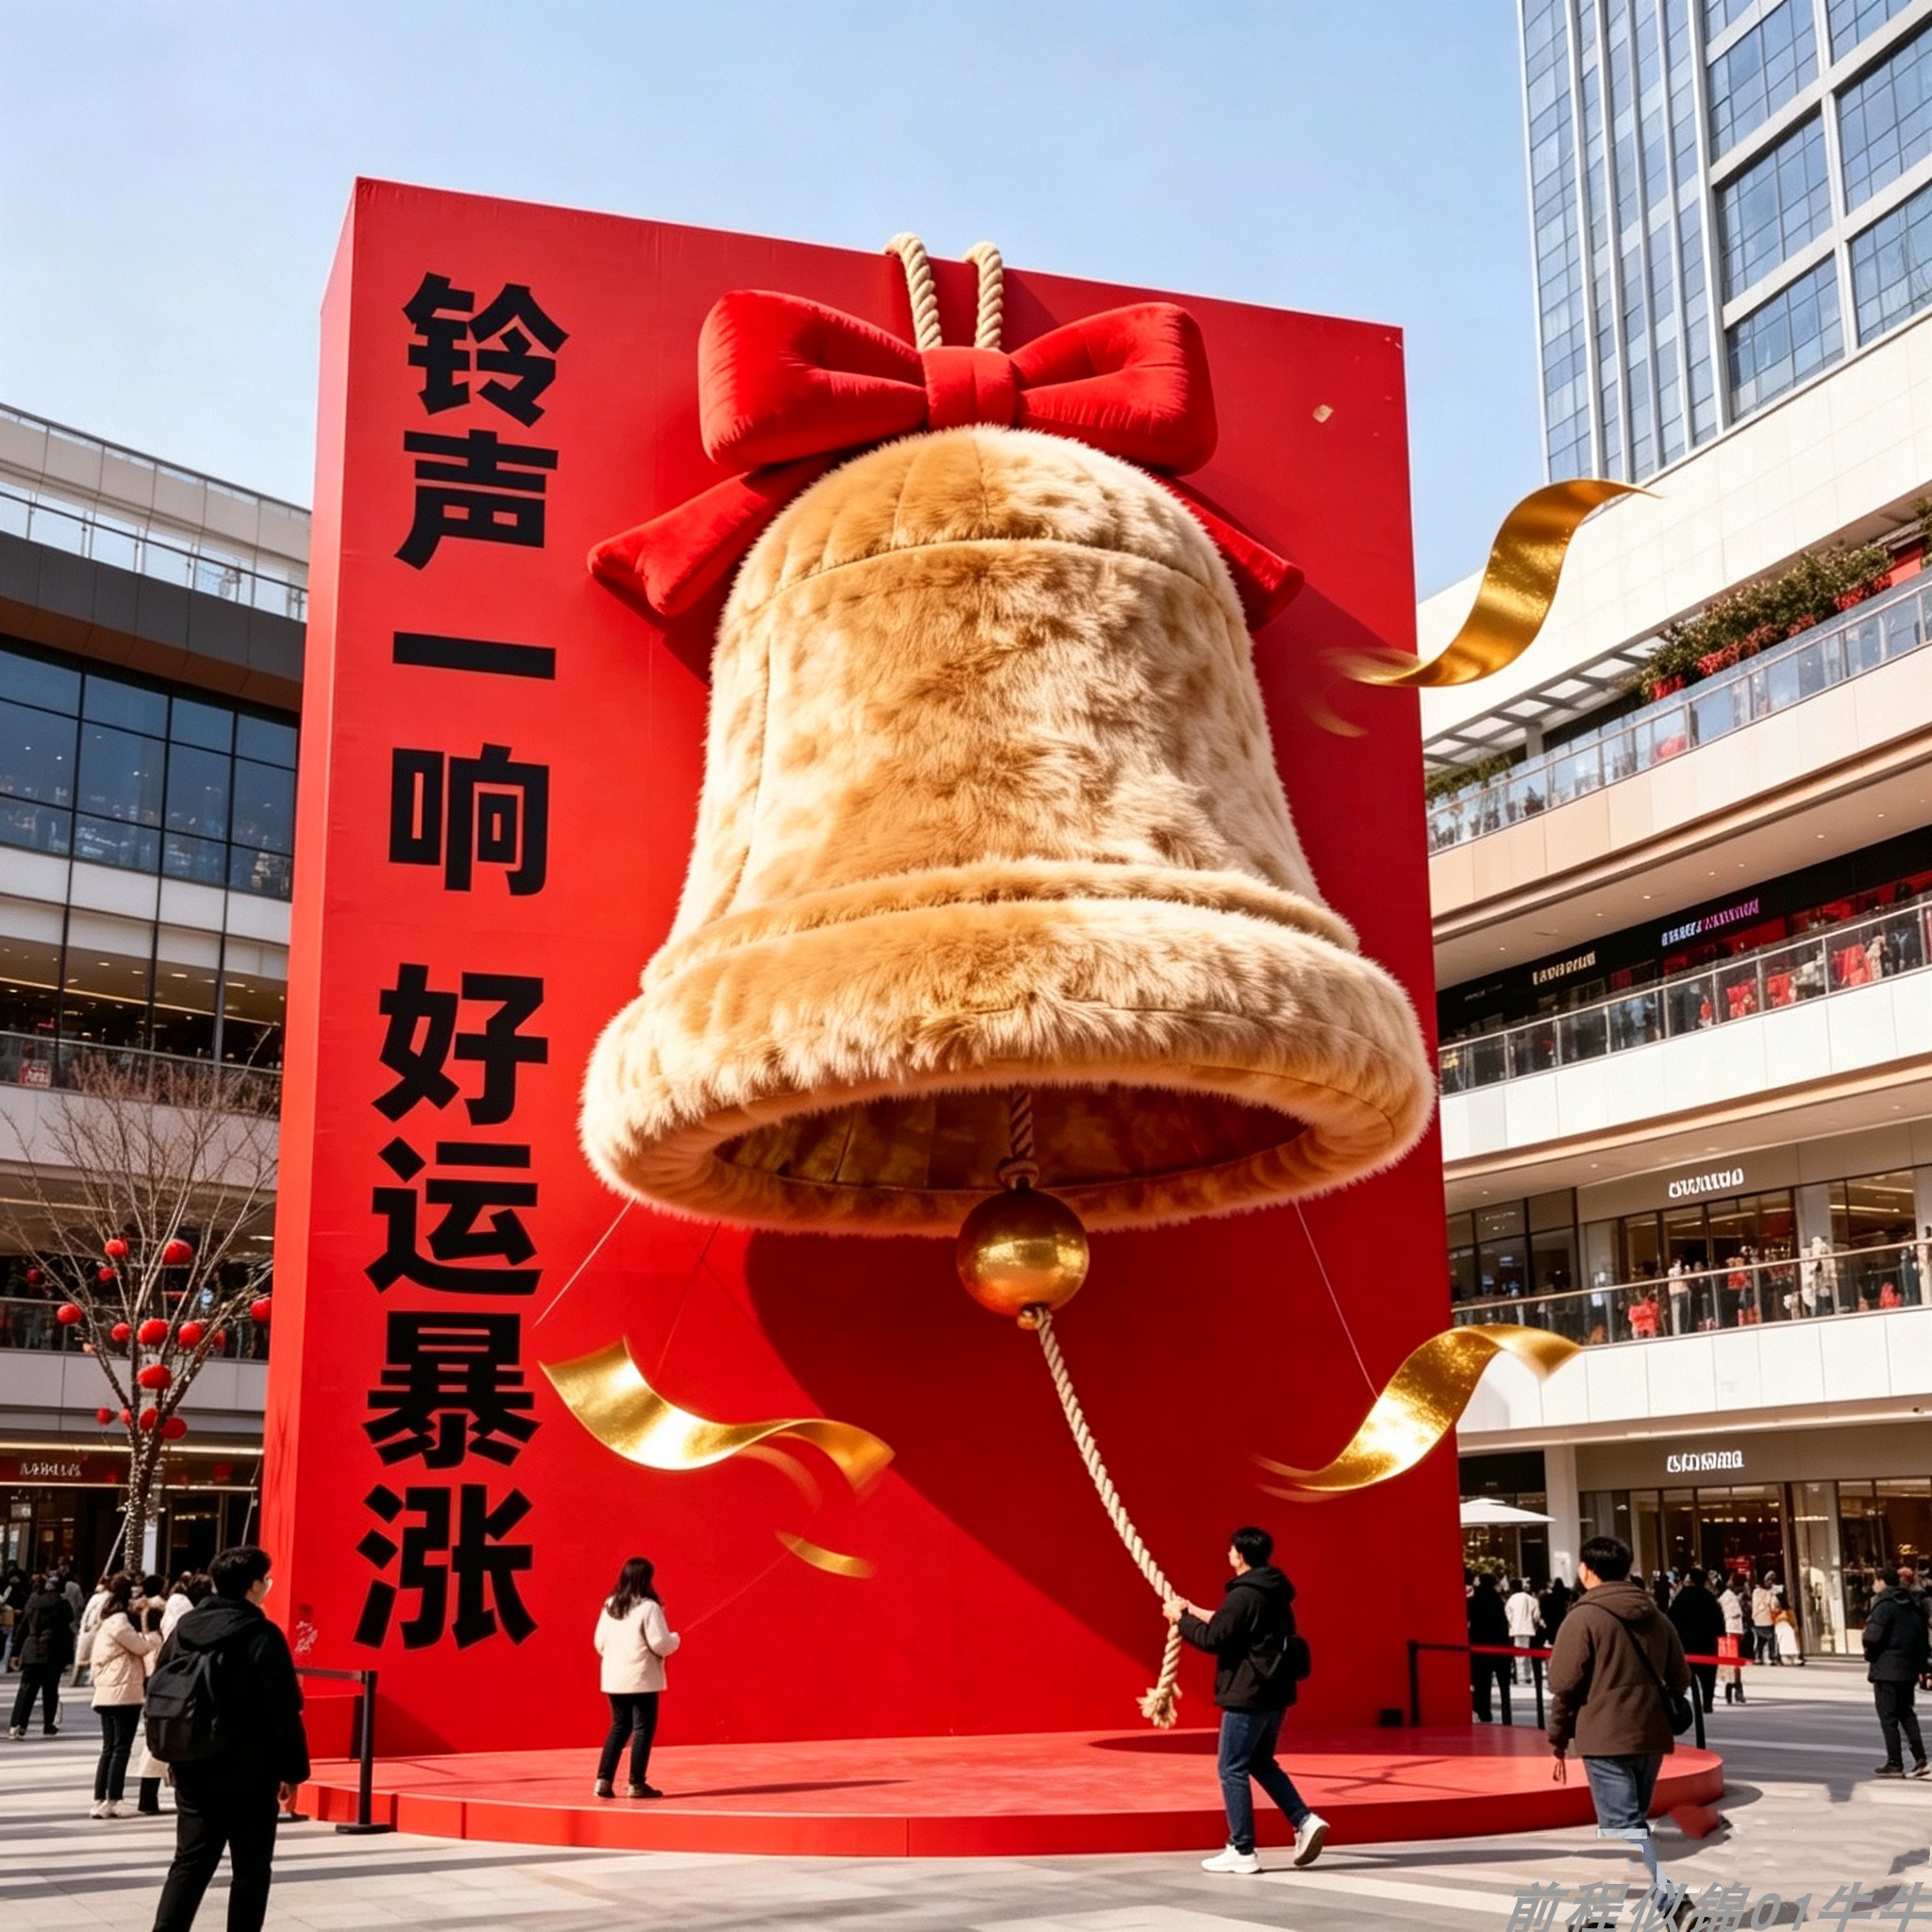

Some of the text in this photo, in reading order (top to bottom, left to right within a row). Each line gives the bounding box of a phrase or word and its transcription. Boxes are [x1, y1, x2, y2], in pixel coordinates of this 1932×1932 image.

[354, 273, 570, 1651] 铃声一响 好运暴涨
